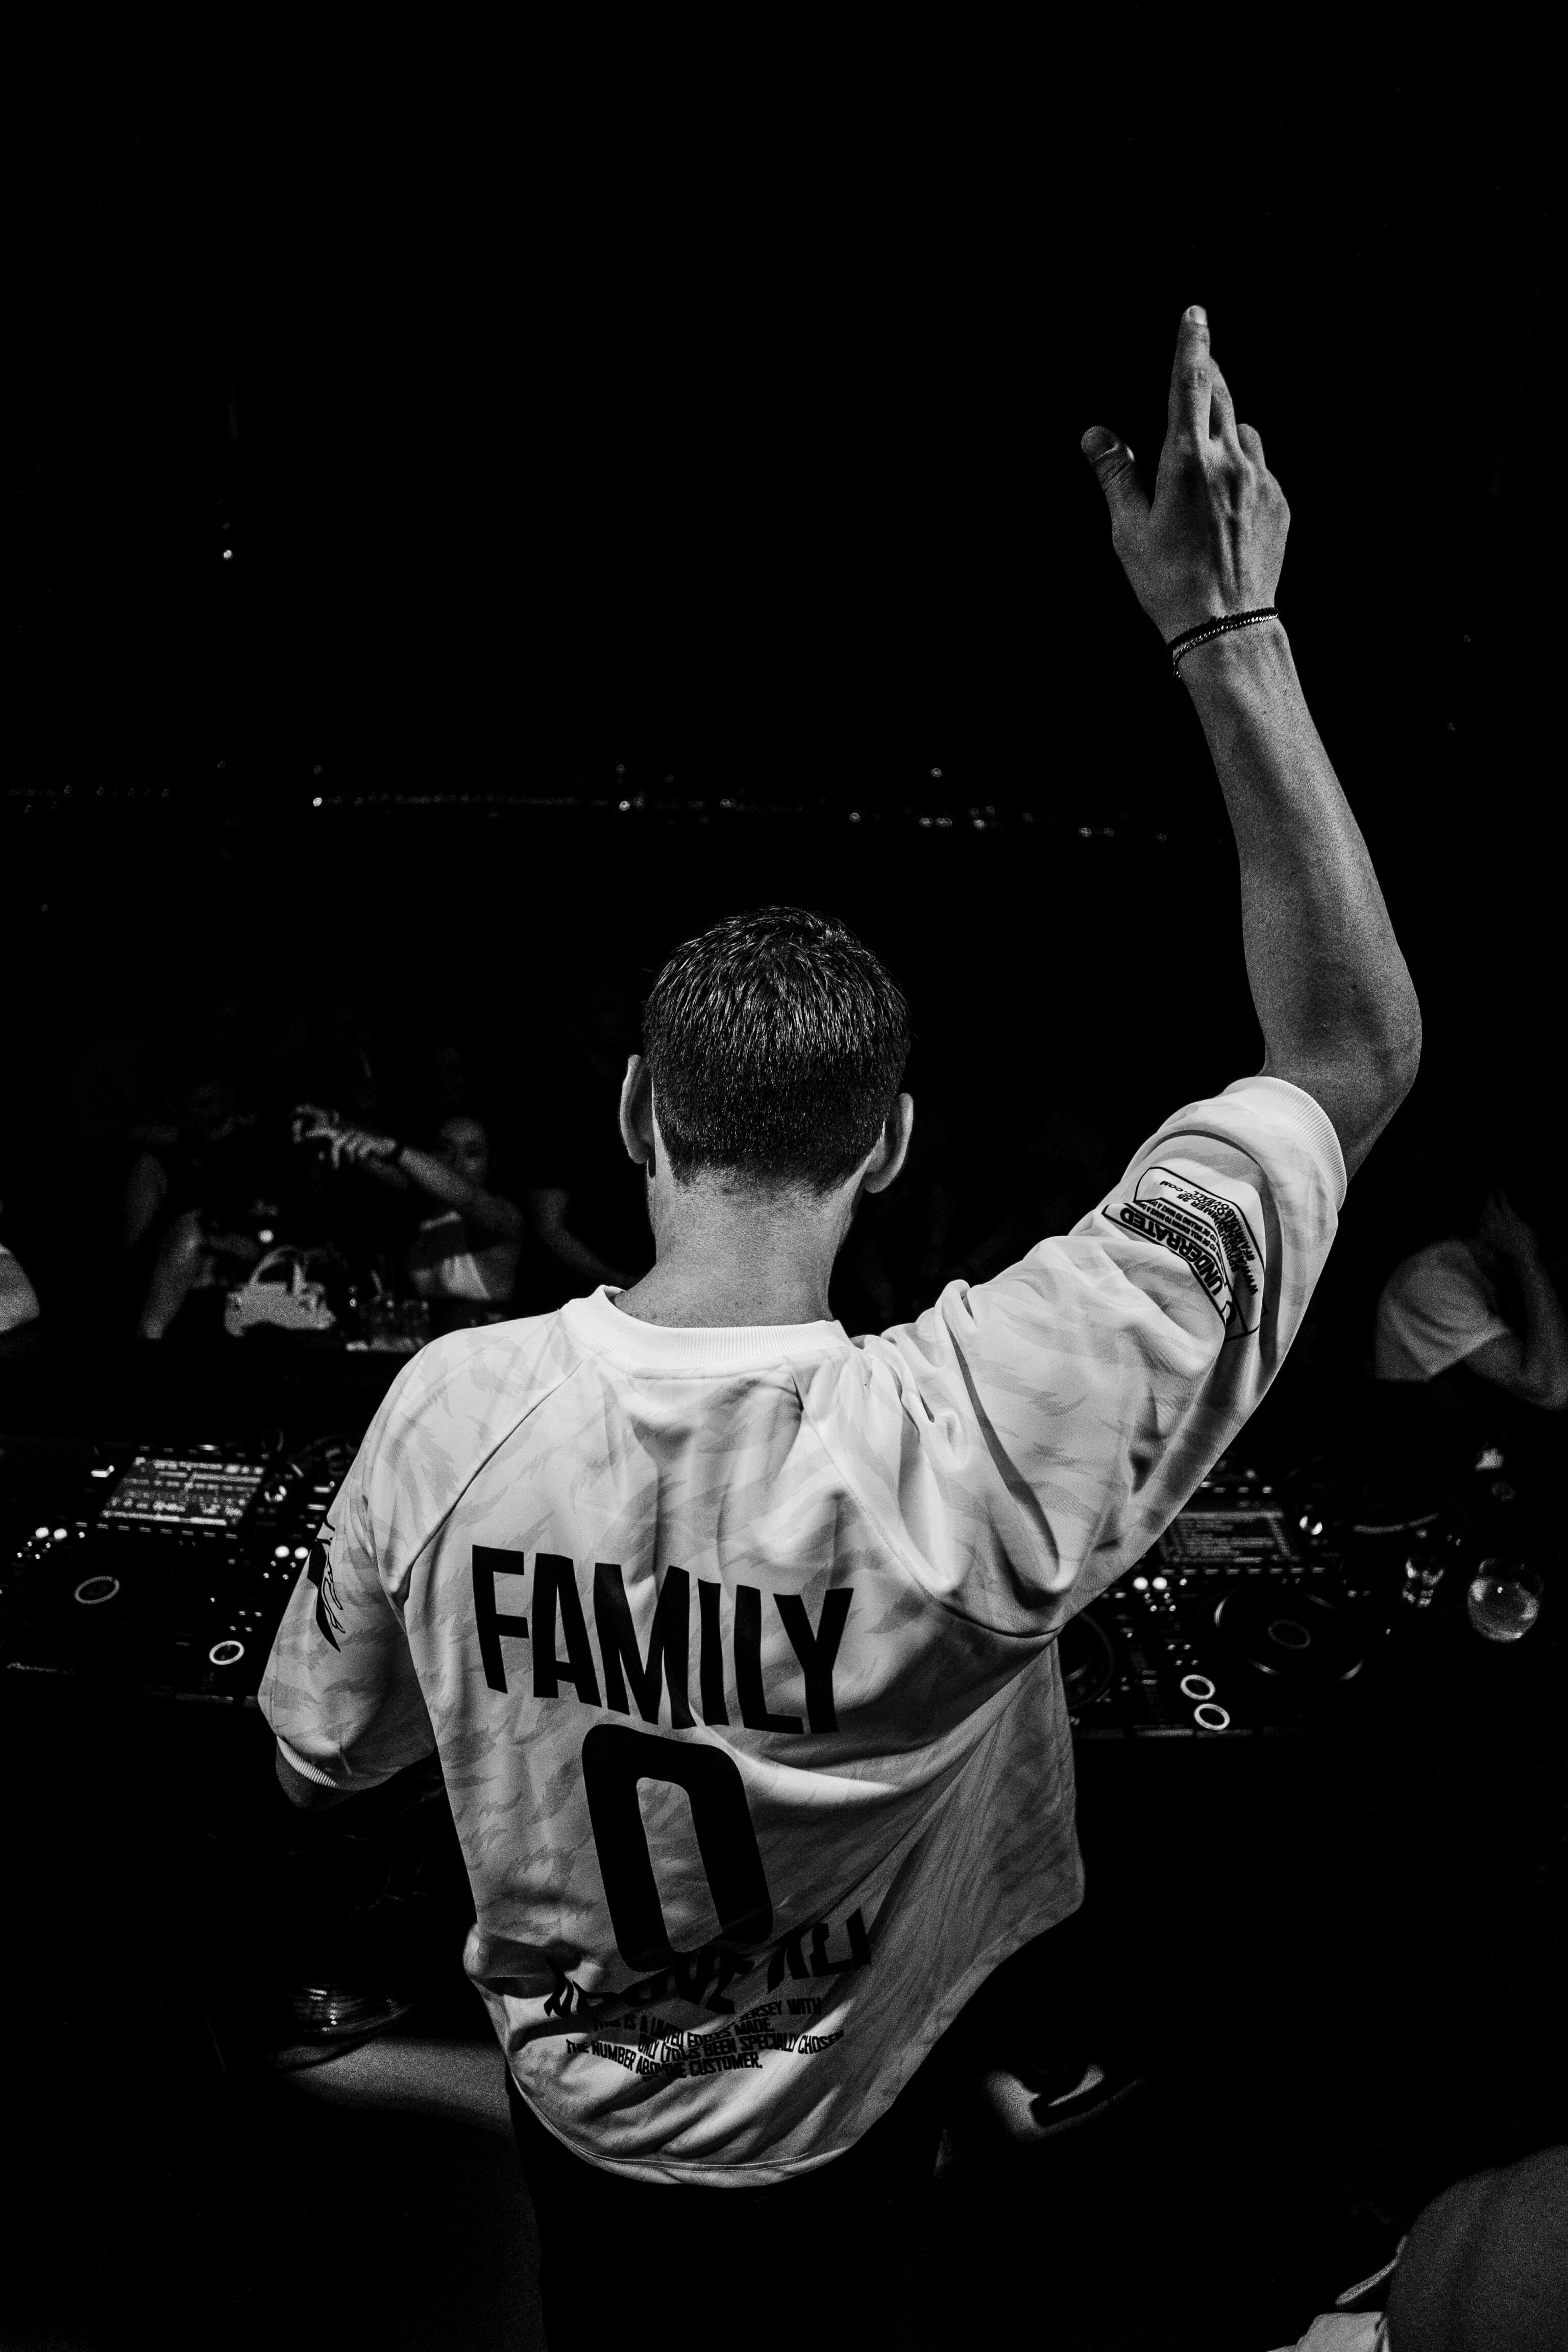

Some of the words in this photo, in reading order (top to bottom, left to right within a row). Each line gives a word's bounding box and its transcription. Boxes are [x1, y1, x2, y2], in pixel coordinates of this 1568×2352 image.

[1177, 1193, 1189, 1202] 25
[1120, 1207, 1223, 1296] UNDERRATED
[1191, 1201, 1236, 1272] SPRING/SUMMER
[472, 1545, 854, 1734] FAMILY
[582, 1723, 773, 1973] 0
[787, 1997, 823, 2015] WITH
[566, 2039, 589, 2054] THE
[592, 2040, 636, 2071] NUMBER
[703, 2038, 737, 2057] BEEN
[798, 2028, 844, 2054] CHOSEN
[690, 2051, 763, 2077] CUSTOMER.
